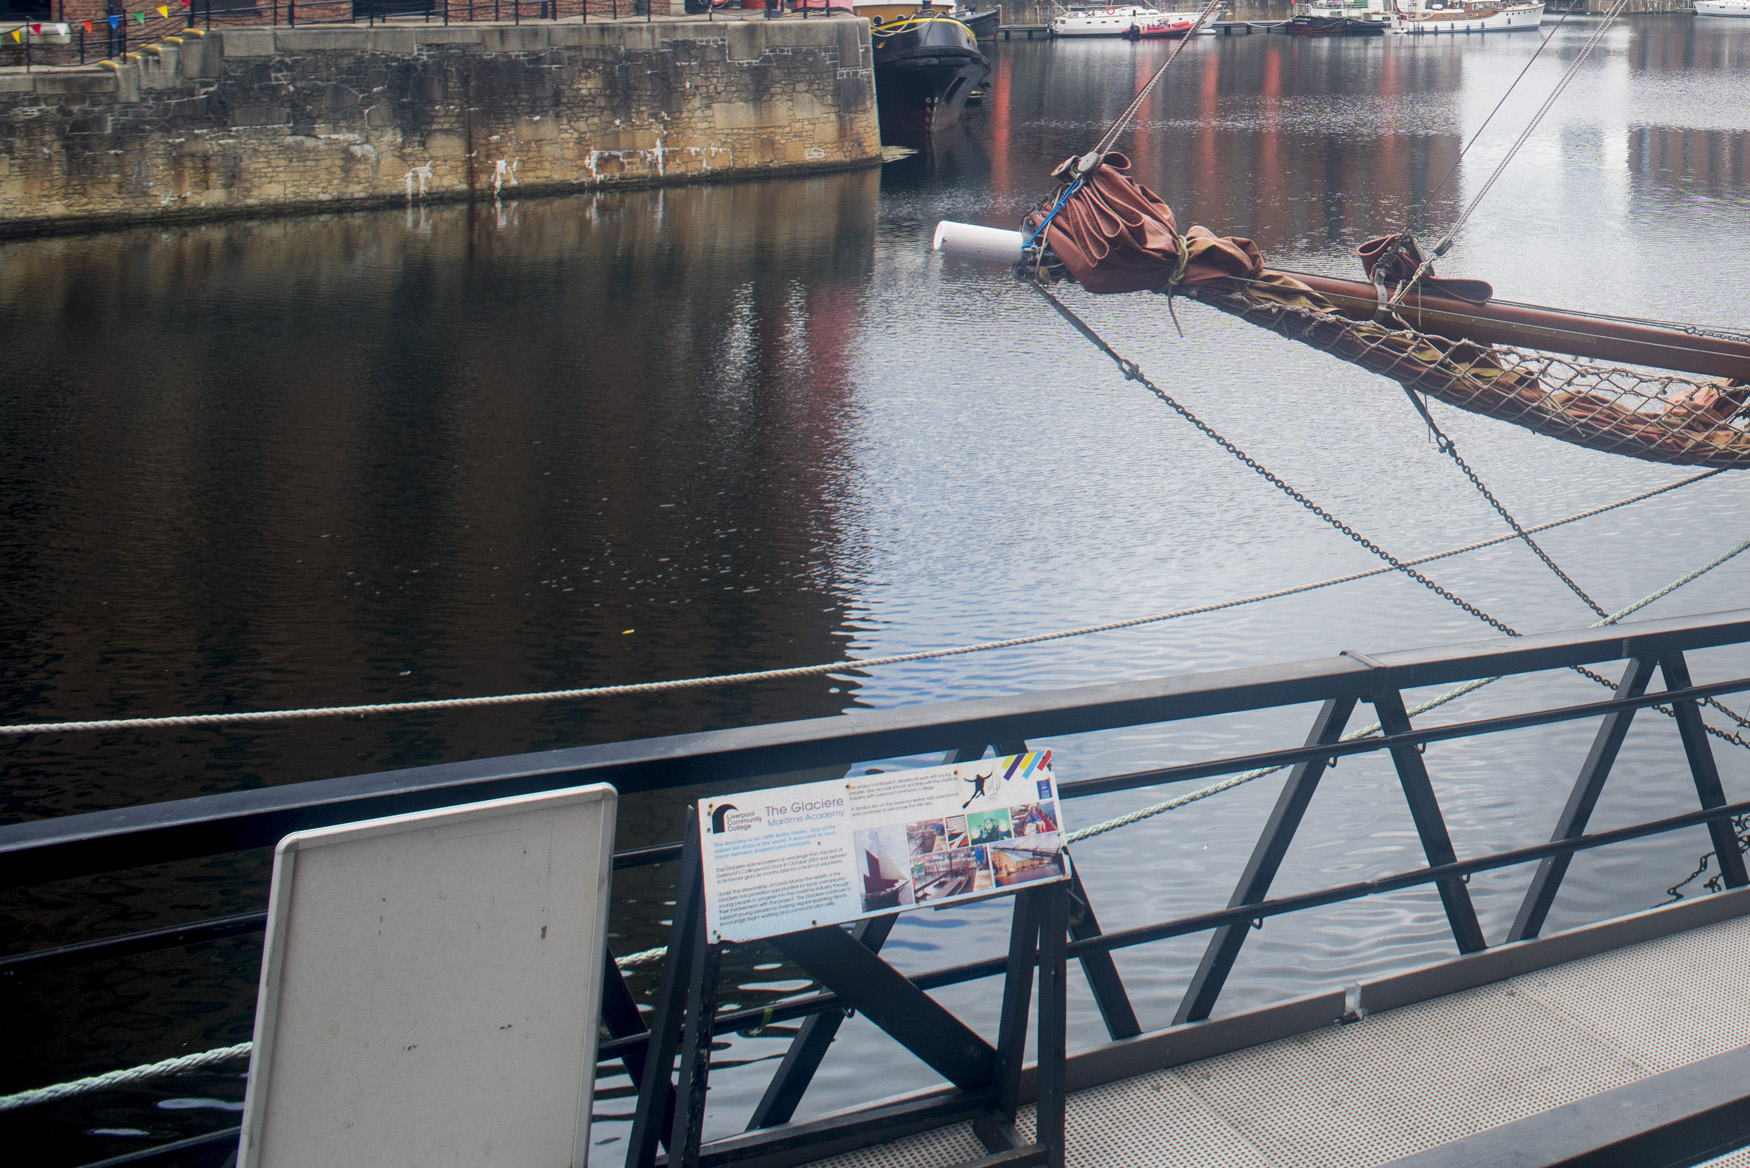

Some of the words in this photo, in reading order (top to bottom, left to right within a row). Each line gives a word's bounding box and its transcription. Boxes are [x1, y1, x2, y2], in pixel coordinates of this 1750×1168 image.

[765, 804, 787, 817] The
[790, 798, 844, 813] Glaciere
[726, 810, 755, 819] Liverpool
[726, 815, 762, 825] Community
[767, 815, 803, 826] Maritime
[805, 809, 845, 820] Academy
